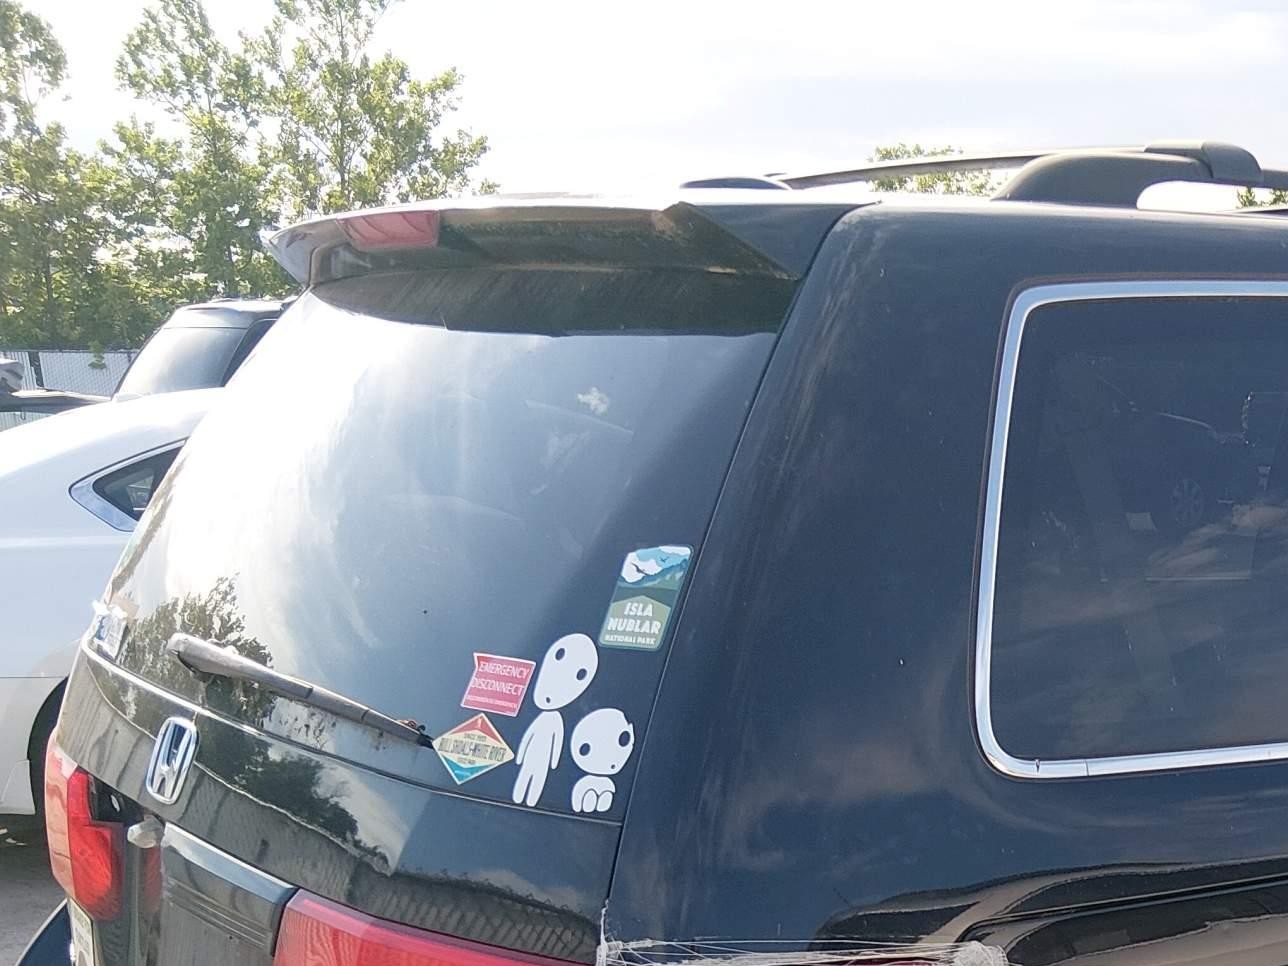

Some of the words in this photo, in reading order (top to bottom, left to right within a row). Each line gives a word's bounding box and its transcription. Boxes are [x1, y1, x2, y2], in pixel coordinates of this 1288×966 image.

[624, 602, 653, 617] ISLA
[607, 617, 662, 635] NUBLAR
[604, 634, 635, 644] NATIONAL
[635, 636, 656, 646] PARK
[479, 660, 530, 679] EMERGENCY
[471, 677, 526, 696] DISCONNECT
